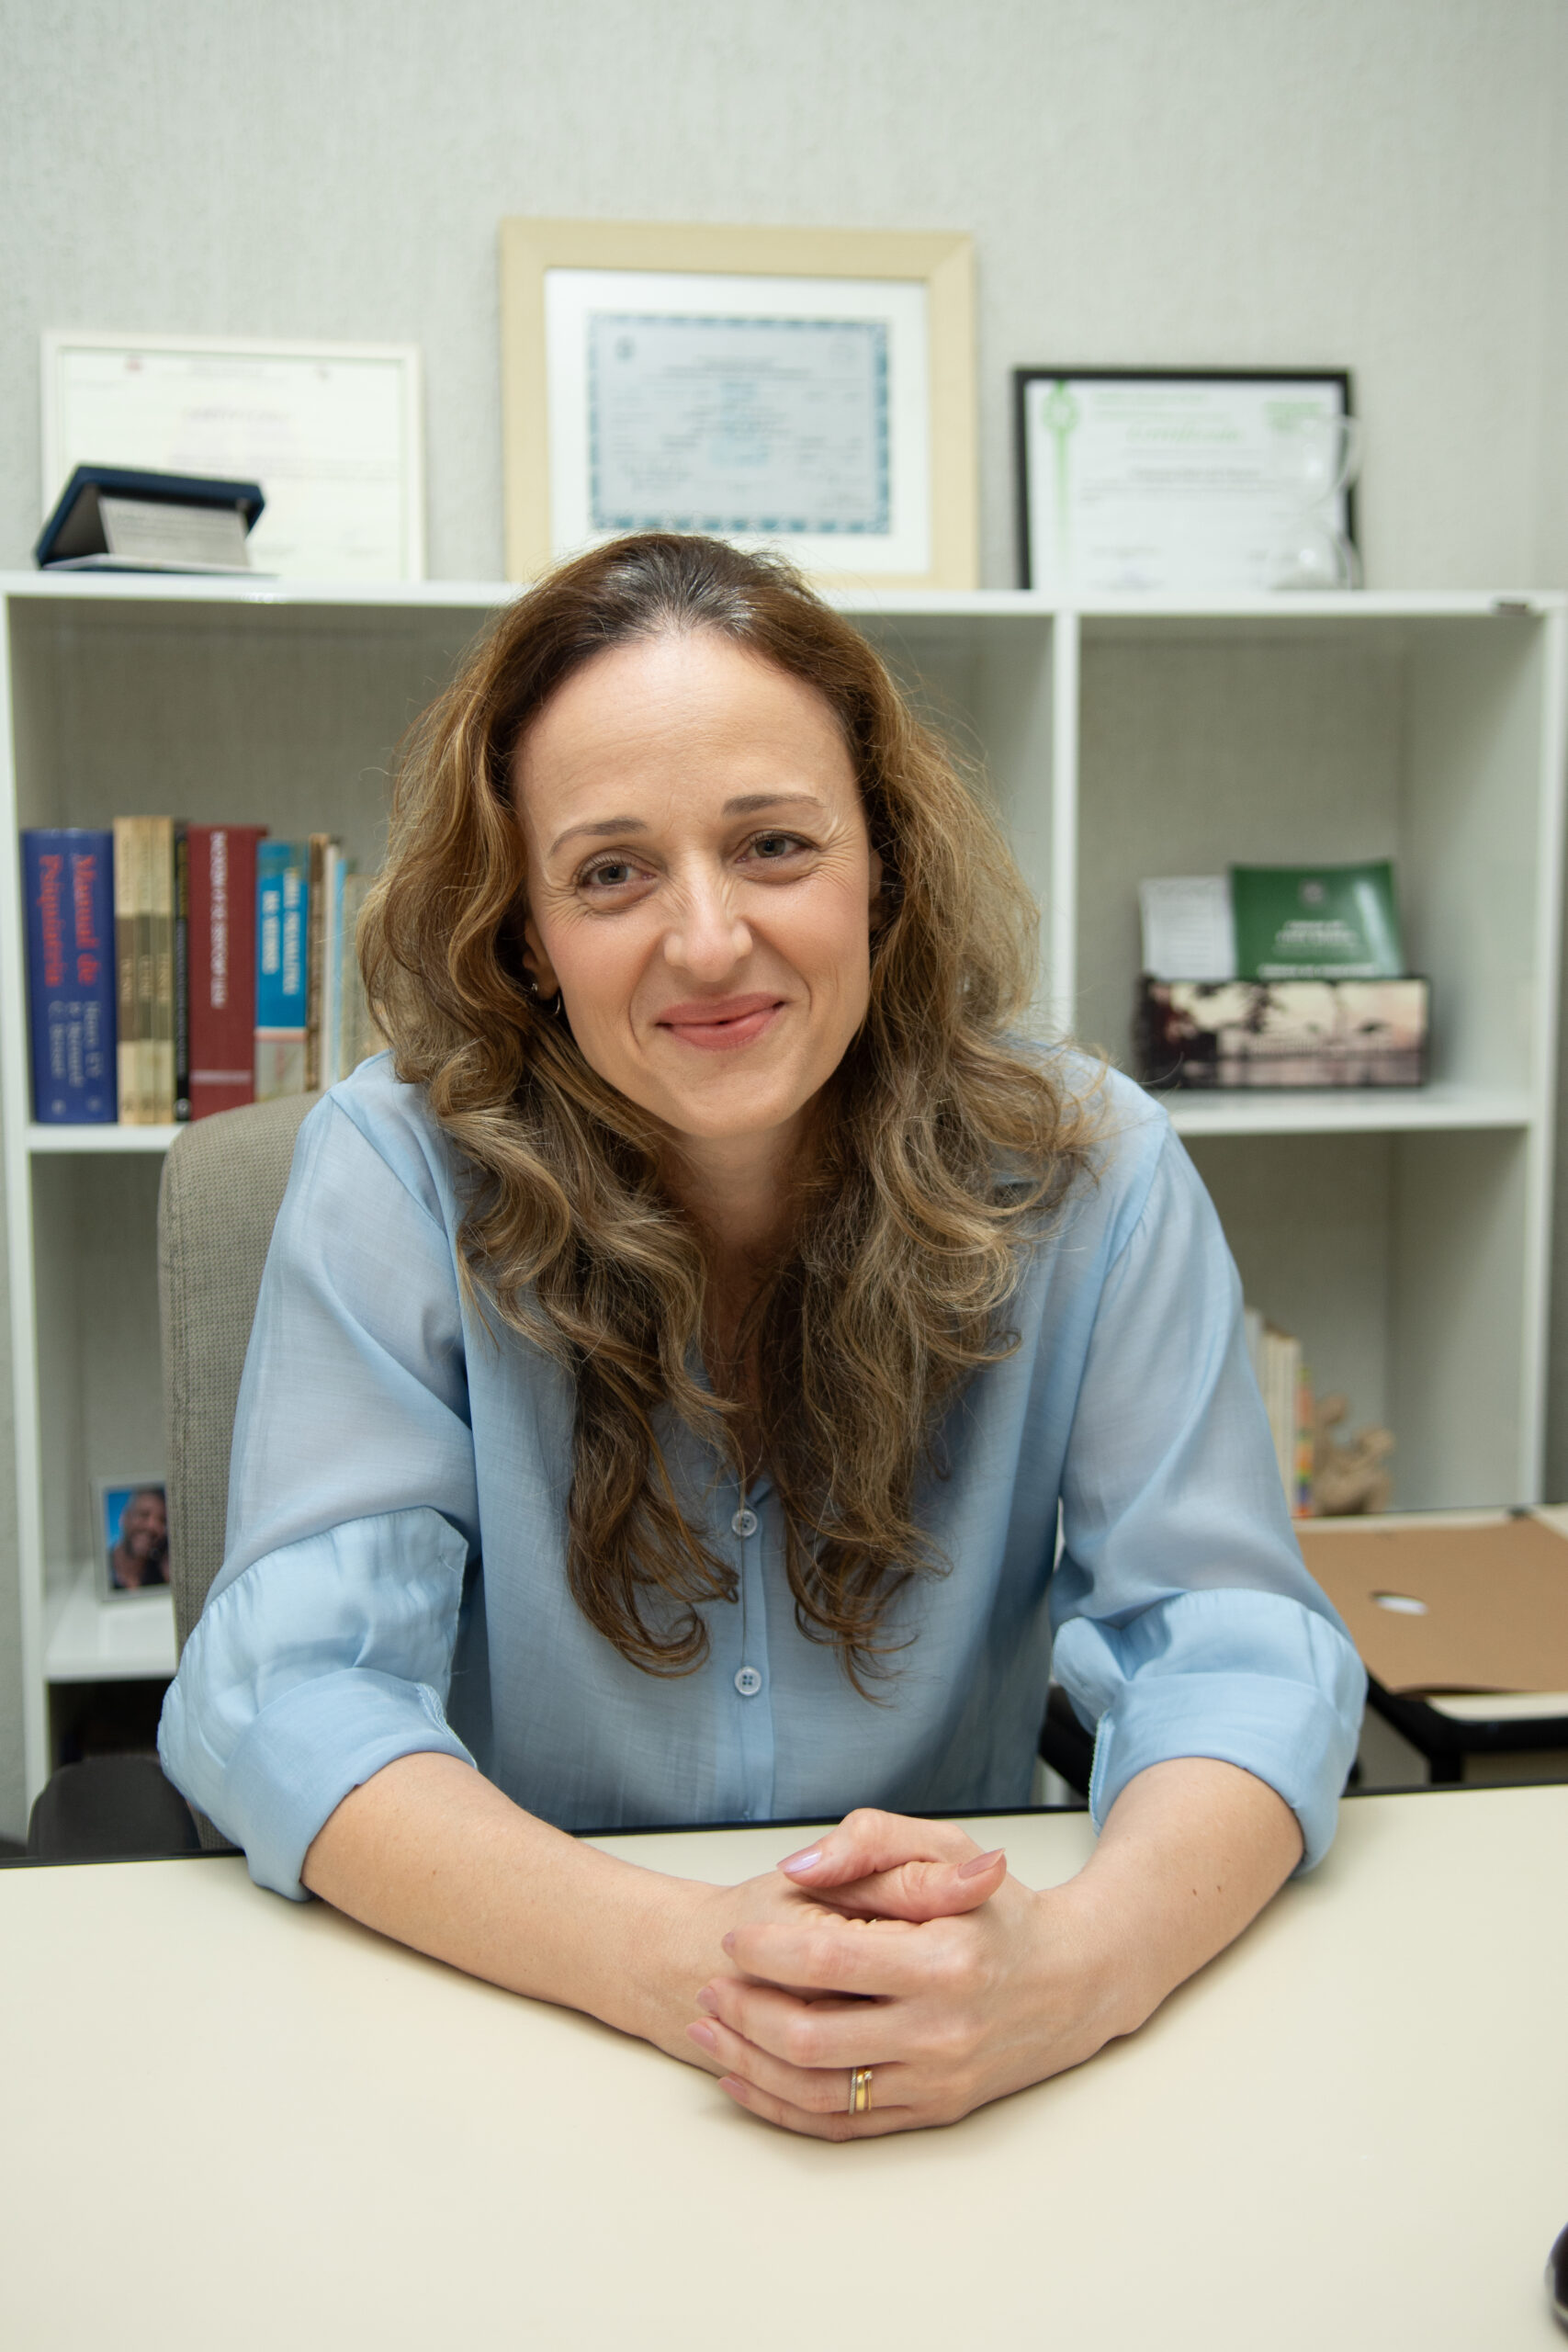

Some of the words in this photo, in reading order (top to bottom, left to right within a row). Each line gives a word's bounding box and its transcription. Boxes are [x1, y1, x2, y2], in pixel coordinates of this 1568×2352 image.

[38, 854, 67, 988] Psiquiatria
[73, 854, 98, 949] Manual
[77, 954, 100, 986] de
